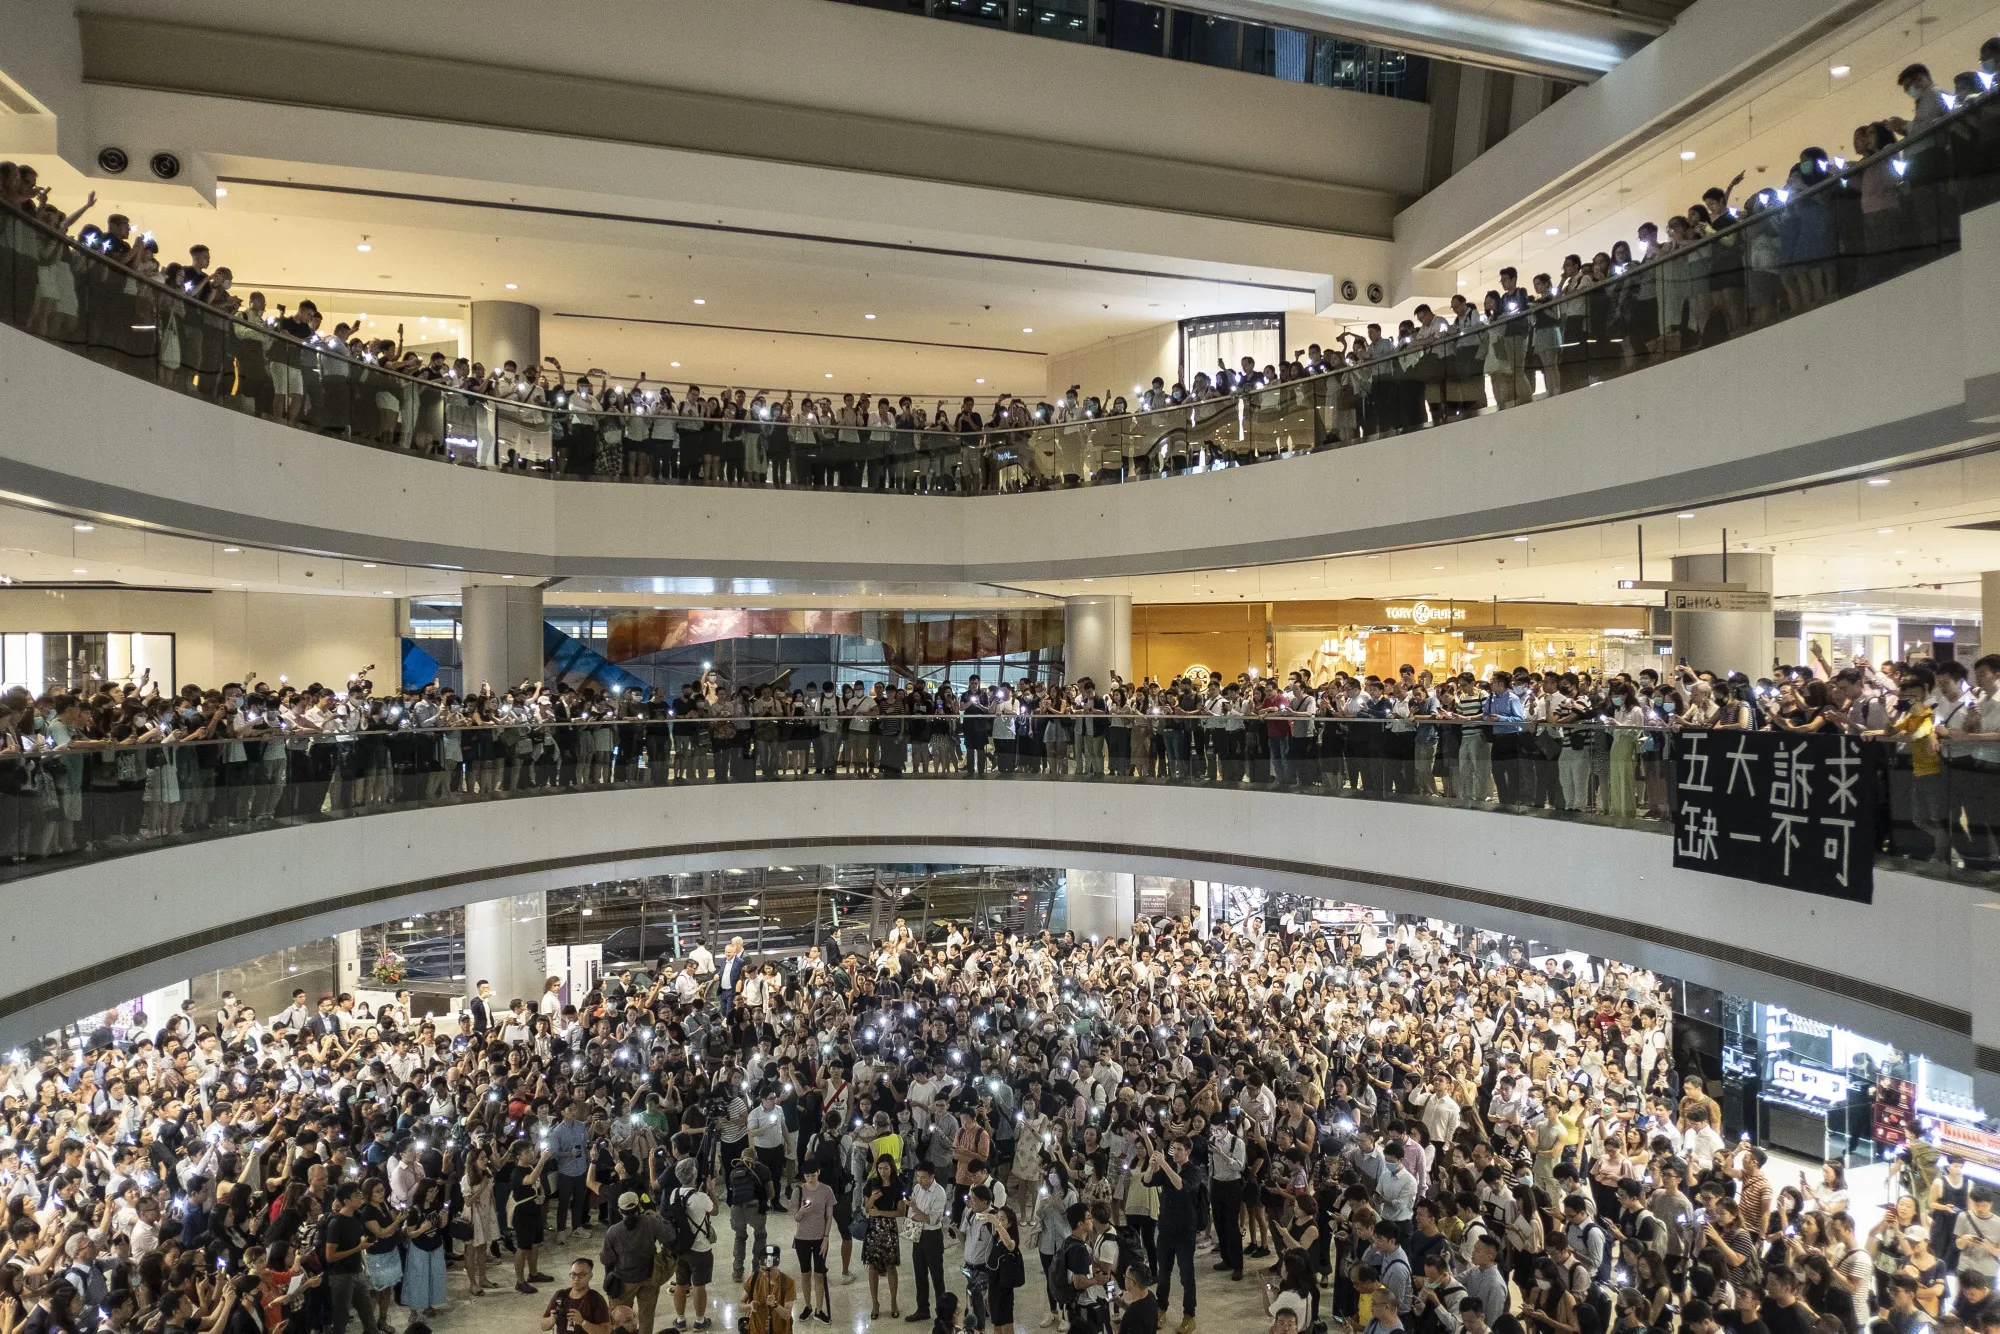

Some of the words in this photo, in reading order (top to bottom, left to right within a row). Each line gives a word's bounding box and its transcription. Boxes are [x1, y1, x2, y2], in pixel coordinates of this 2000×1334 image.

[1386, 607, 1412, 618] TORY
[1430, 608, 1466, 619] BURCH
[1678, 732, 1861, 814] 五大訴求
[1677, 801, 1855, 887] 缺一不可
